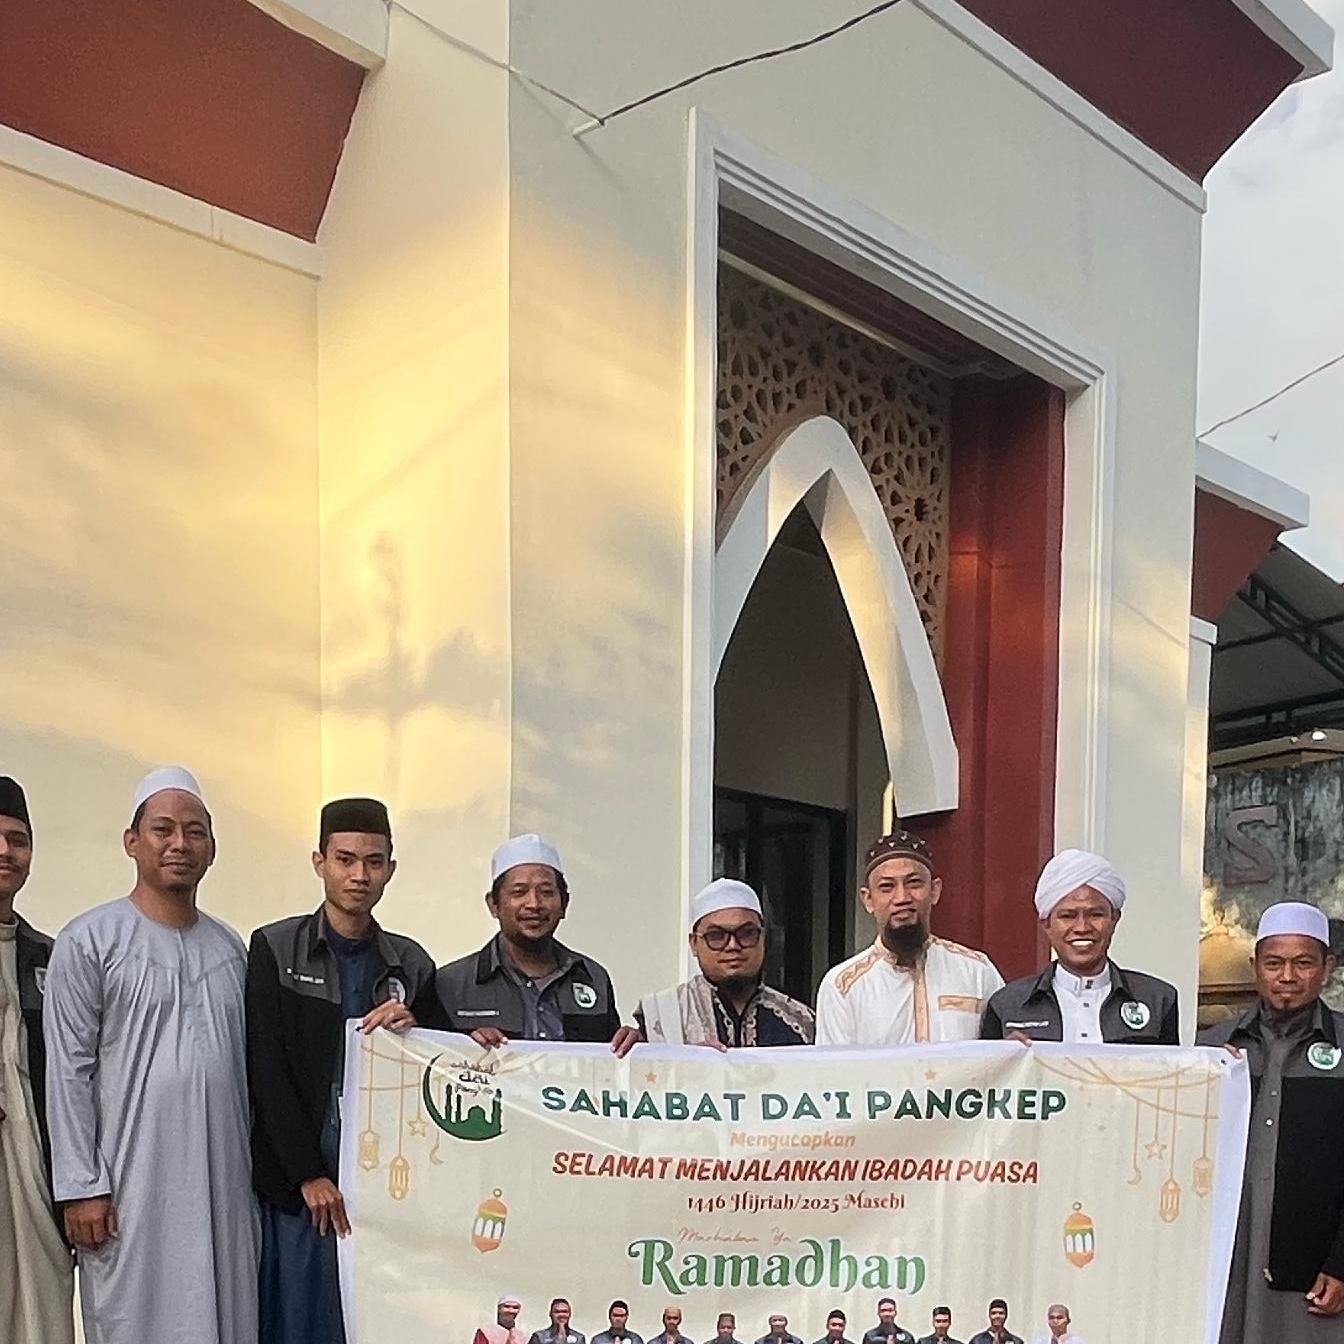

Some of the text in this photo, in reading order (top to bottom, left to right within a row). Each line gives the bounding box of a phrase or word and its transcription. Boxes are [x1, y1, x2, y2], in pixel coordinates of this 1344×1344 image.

[541, 1086, 1066, 1121] SAHABAT DA'I PANGKEP
[730, 1131, 856, 1150] Mengucapkan
[552, 1152, 1039, 1183] SELAMAT MENJALANKAN IBADAH PUASA
[688, 1194, 726, 1212] 1446
[730, 1190, 839, 1213] Hijriah/2025
[627, 1238, 926, 1295] Ramadhan
